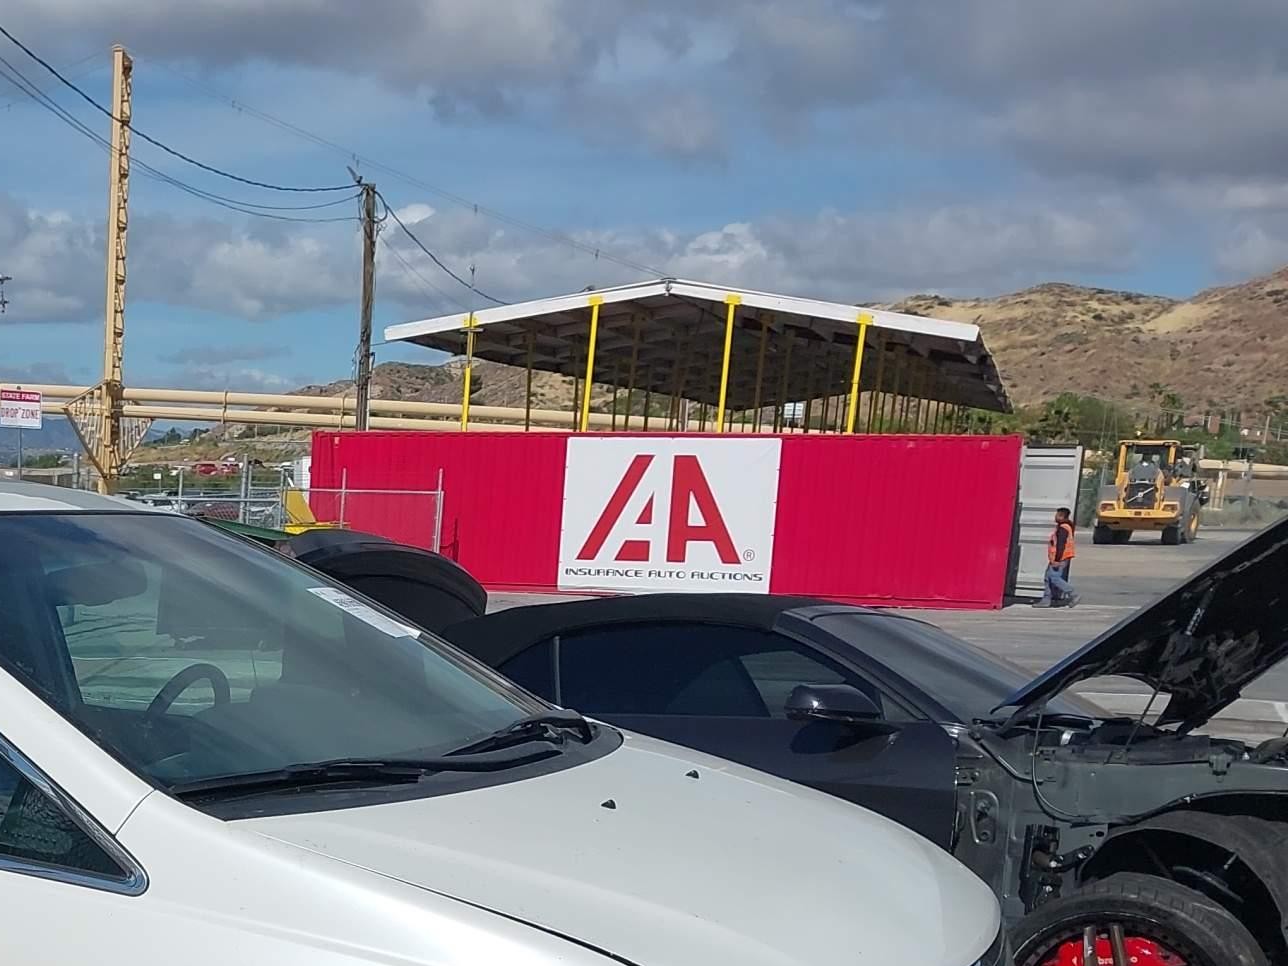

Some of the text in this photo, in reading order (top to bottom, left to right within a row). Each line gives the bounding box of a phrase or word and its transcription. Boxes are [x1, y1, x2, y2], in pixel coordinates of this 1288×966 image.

[21, 409, 40, 419] ZONE
[564, 567, 764, 582] INSURANCE AUTO AUCTIONS
